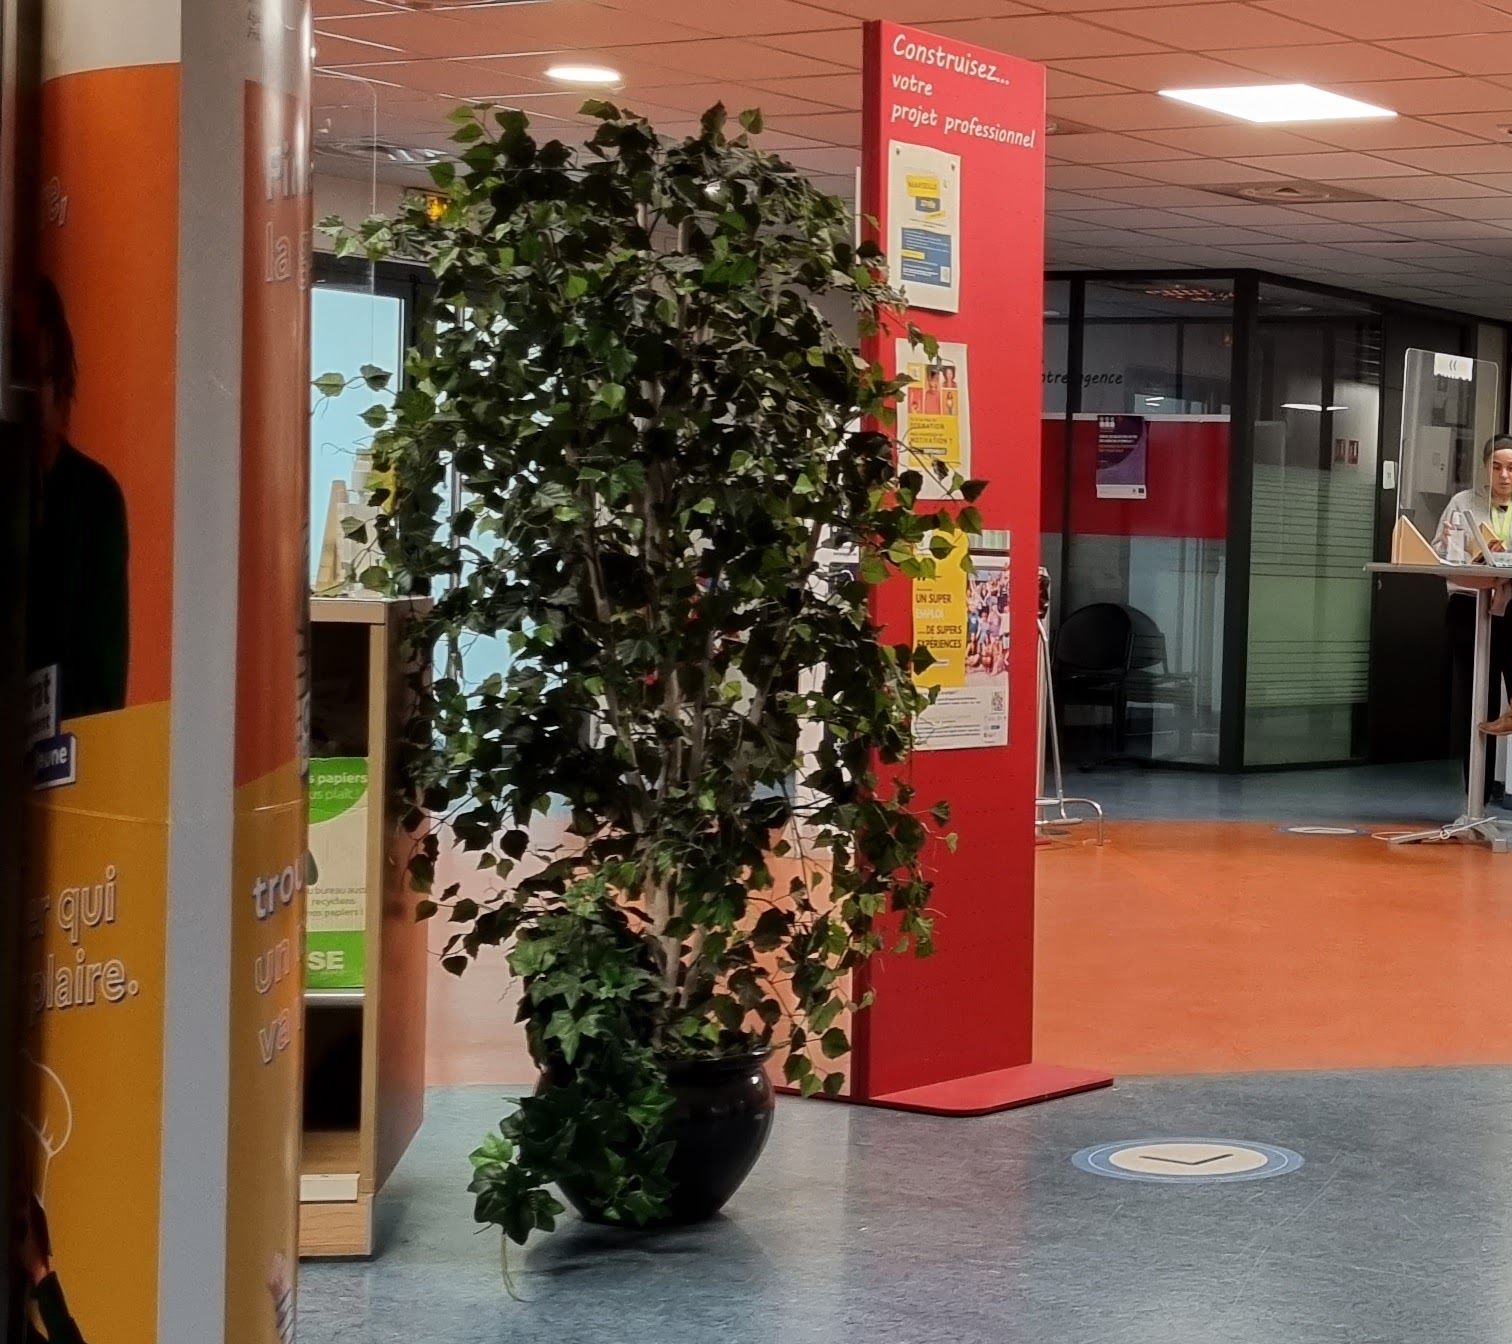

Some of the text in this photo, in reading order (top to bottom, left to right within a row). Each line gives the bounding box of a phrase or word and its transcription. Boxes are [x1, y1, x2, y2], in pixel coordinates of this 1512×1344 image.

[893, 34, 1010, 85] Construisez...
[892, 74, 933, 96] votre
[891, 104, 1035, 148] projet professionnel
[1081, 373, 1123, 387] gence
[916, 594, 952, 604] UN SUPER
[936, 625, 962, 635] SUPERS
[317, 772, 368, 785] papiers
[57, 865, 116, 944] qui
[254, 938, 291, 994] un
